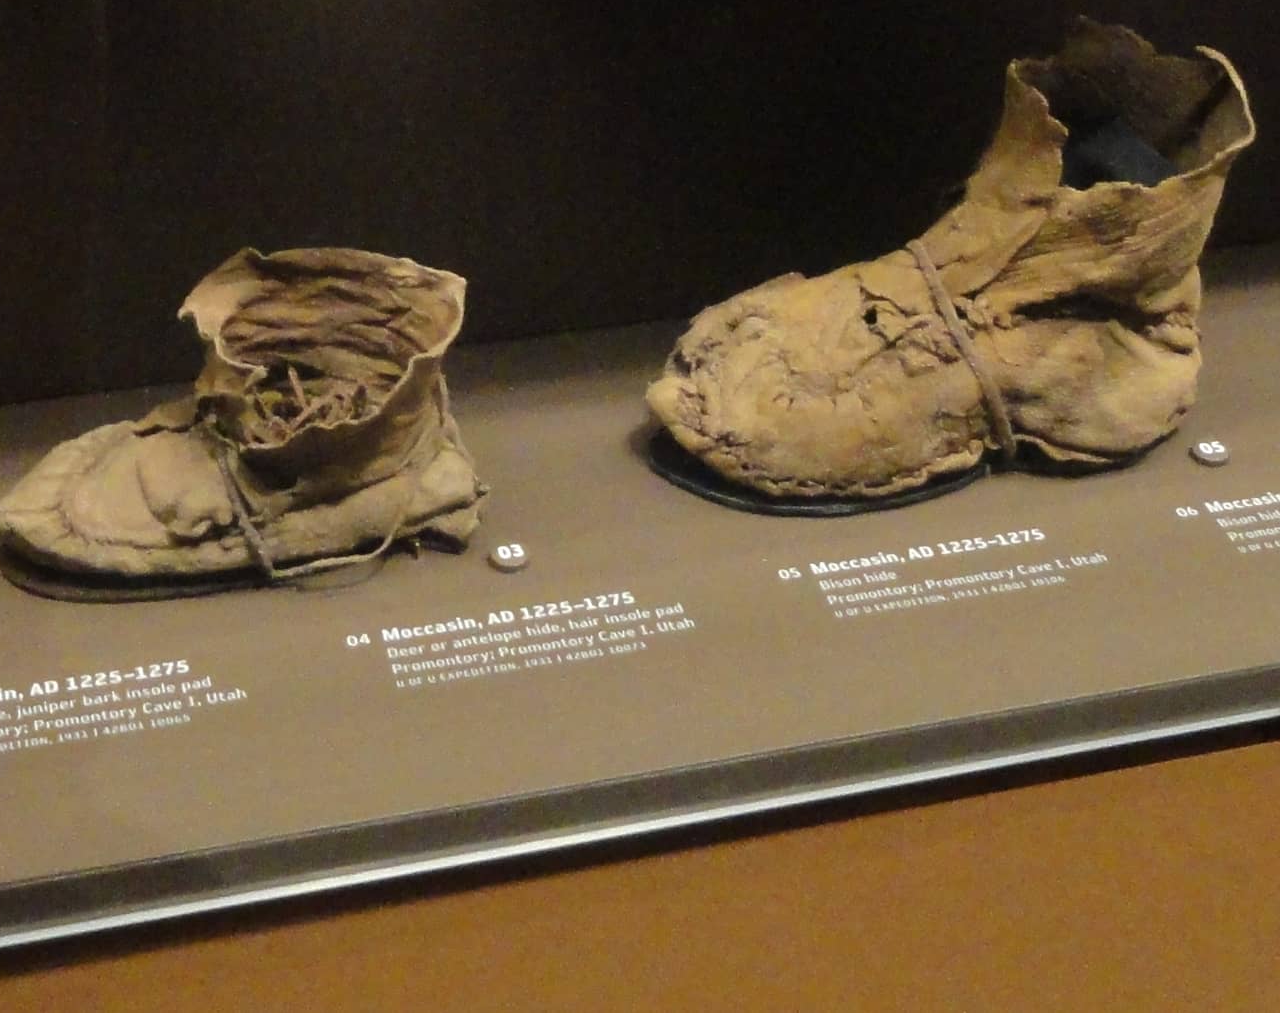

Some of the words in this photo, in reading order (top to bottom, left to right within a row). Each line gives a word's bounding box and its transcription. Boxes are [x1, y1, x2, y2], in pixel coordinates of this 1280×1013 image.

[1198, 440, 1226, 455] 05
[1175, 505, 1198, 517] 06
[496, 543, 525, 560] 03
[777, 566, 801, 580] 05
[809, 551, 905, 574] Moccasin,
[908, 545, 934, 559] AD
[818, 577, 862, 590] Bison
[862, 570, 896, 583] hide
[924, 569, 1014, 589] Promontory
[1016, 562, 1052, 575] Cave
[1069, 552, 1107, 566] Utah
[345, 633, 370, 647] 04
[381, 616, 483, 641] Moccasin,
[487, 610, 514, 625] AD
[386, 644, 424, 658] Deer
[430, 641, 447, 652] or
[453, 630, 521, 648] antelope
[567, 616, 598, 630] hair
[603, 608, 650, 623] insole
[654, 602, 684, 619] pad
[497, 635, 593, 657] Promontory
[597, 628, 635, 641] Cave
[655, 617, 695, 632] Utah
[16, 699, 75, 719] juniper
[82, 690, 120, 706] bark
[125, 682, 175, 698] insole
[180, 675, 212, 694] pad
[29, 679, 59, 696] AD
[33, 707, 136, 730] Promontory
[141, 700, 182, 714] Cave
[205, 687, 247, 704] Utah
